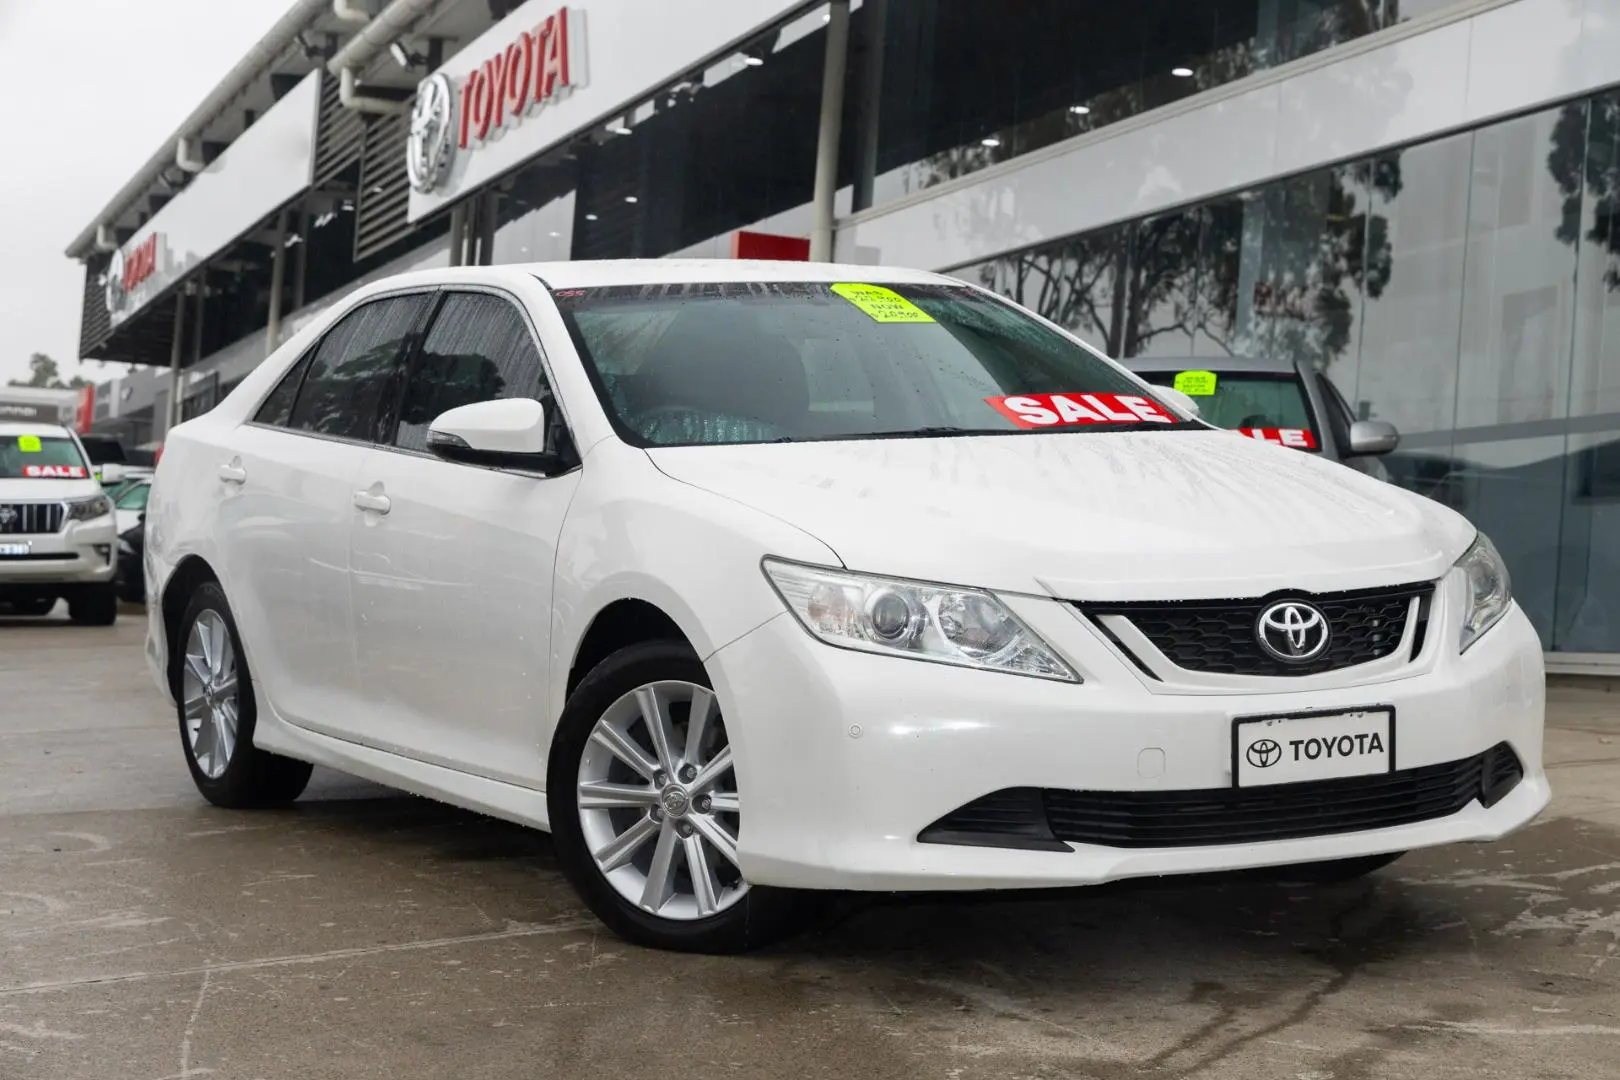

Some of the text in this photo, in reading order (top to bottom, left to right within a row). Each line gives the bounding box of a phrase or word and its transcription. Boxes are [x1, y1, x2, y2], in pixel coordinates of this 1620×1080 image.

[458, 6, 569, 149] TOYOTA
[1004, 394, 1172, 425] SALE
[27, 466, 84, 478] SALE
[1289, 732, 1384, 761] TOYOTA
